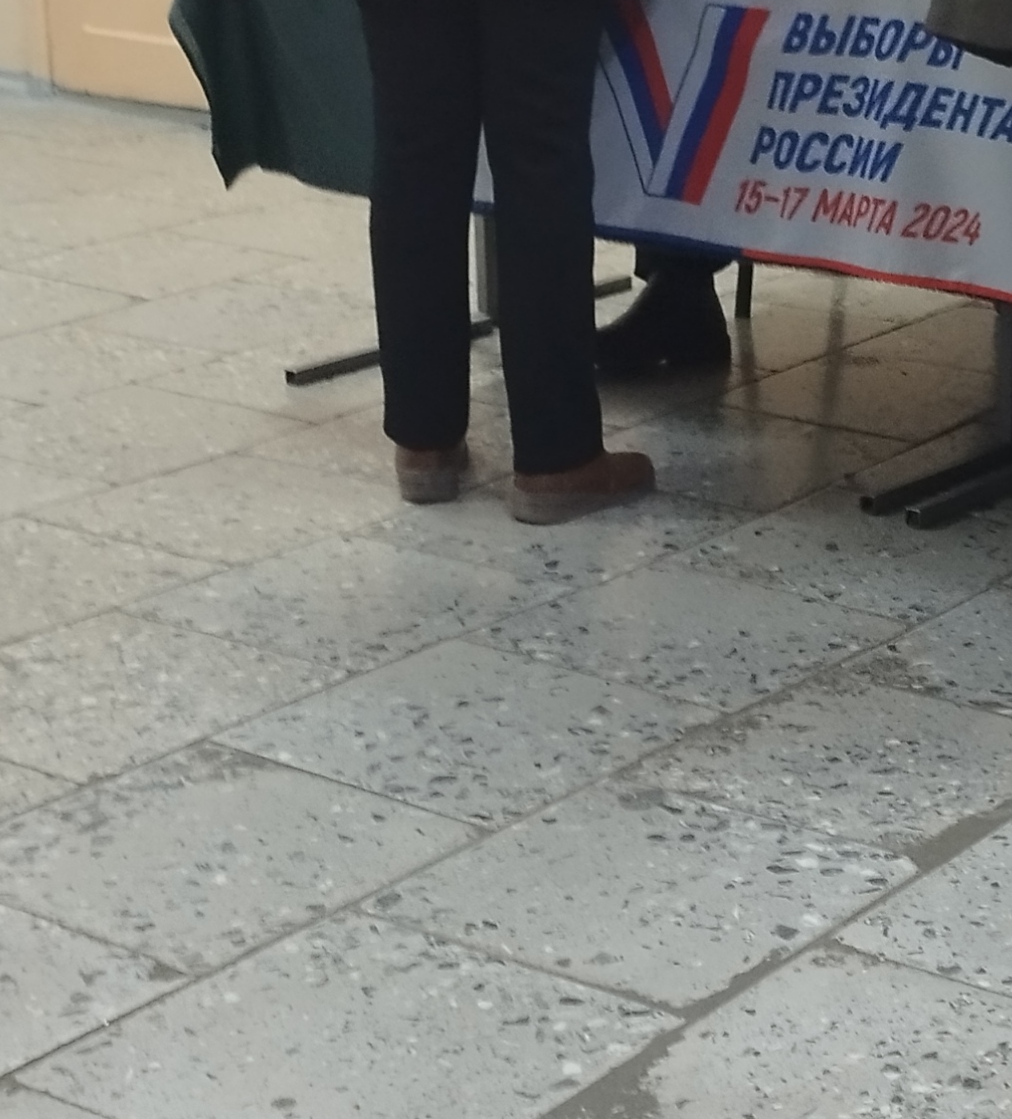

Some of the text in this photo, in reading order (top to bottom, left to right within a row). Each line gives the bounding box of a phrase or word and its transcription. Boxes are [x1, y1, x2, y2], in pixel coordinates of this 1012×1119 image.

[782, 12, 965, 70] ВЫБОРЫ
[749, 126, 904, 182] РОССИИ
[811, 188, 898, 236] МАРТА
[900, 203, 982, 246] 2024
